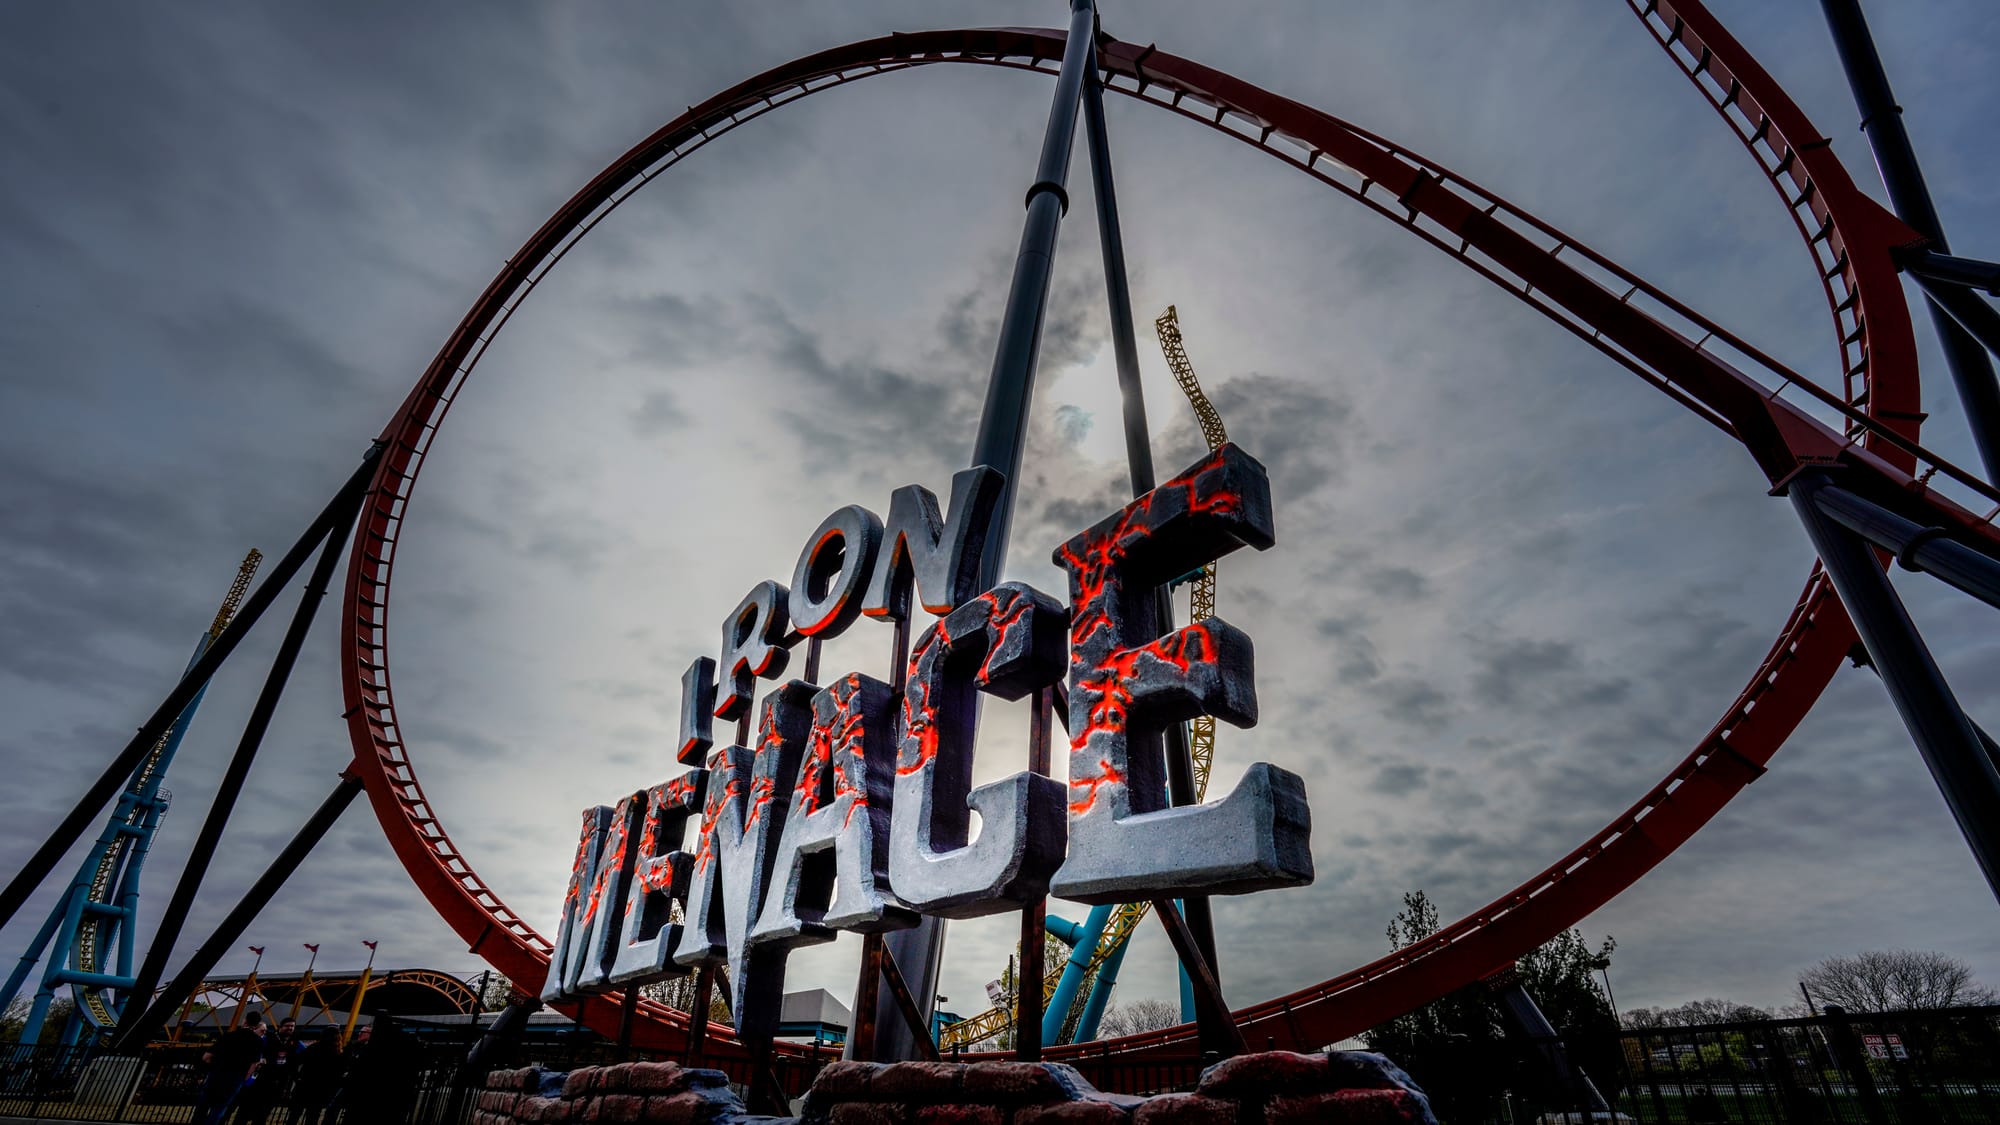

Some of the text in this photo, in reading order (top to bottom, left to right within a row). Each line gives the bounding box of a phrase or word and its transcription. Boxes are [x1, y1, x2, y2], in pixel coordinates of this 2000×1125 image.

[541, 442, 1313, 1038] MENACE
[677, 464, 1004, 764] IRON
[1865, 1036, 1899, 1044] DANER
